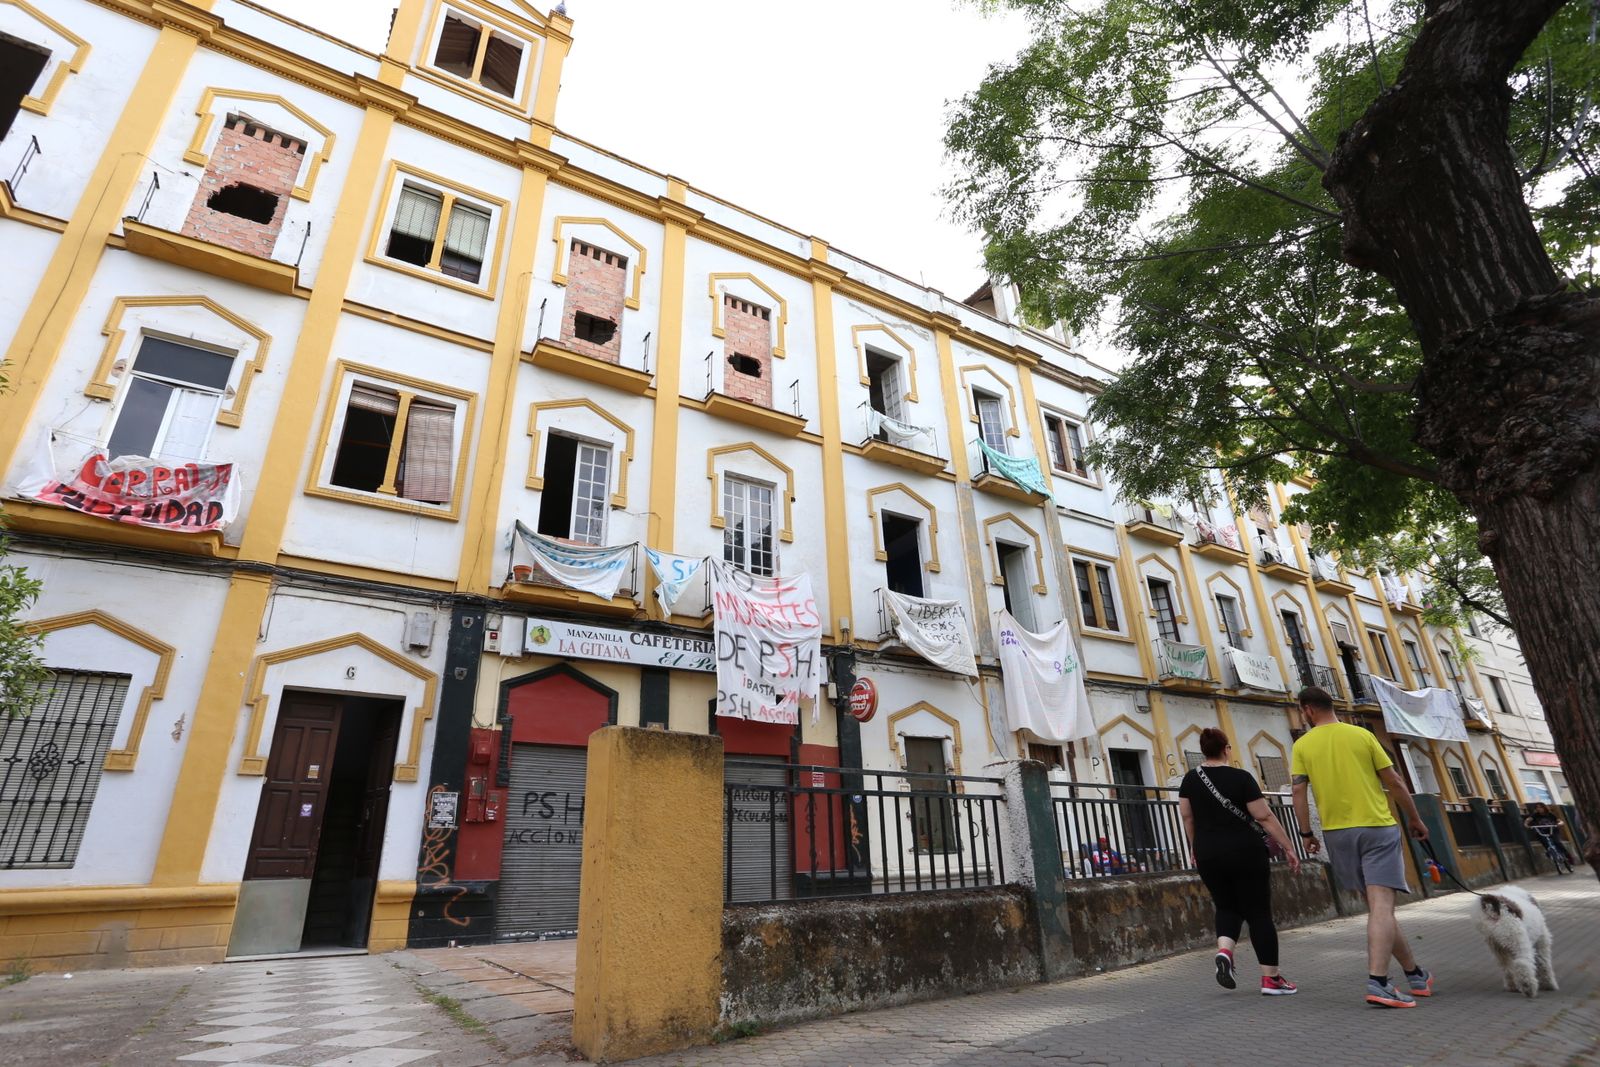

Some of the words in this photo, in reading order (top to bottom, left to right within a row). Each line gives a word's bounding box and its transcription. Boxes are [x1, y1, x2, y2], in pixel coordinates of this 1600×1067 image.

[715, 591, 821, 632] MUERTES
[566, 628, 623, 643] MANZANILLA
[558, 639, 576, 654] LA
[580, 642, 631, 660] GITANA
[718, 631, 747, 670] DE
[658, 651, 680, 667] El
[346, 666, 355, 680] 6
